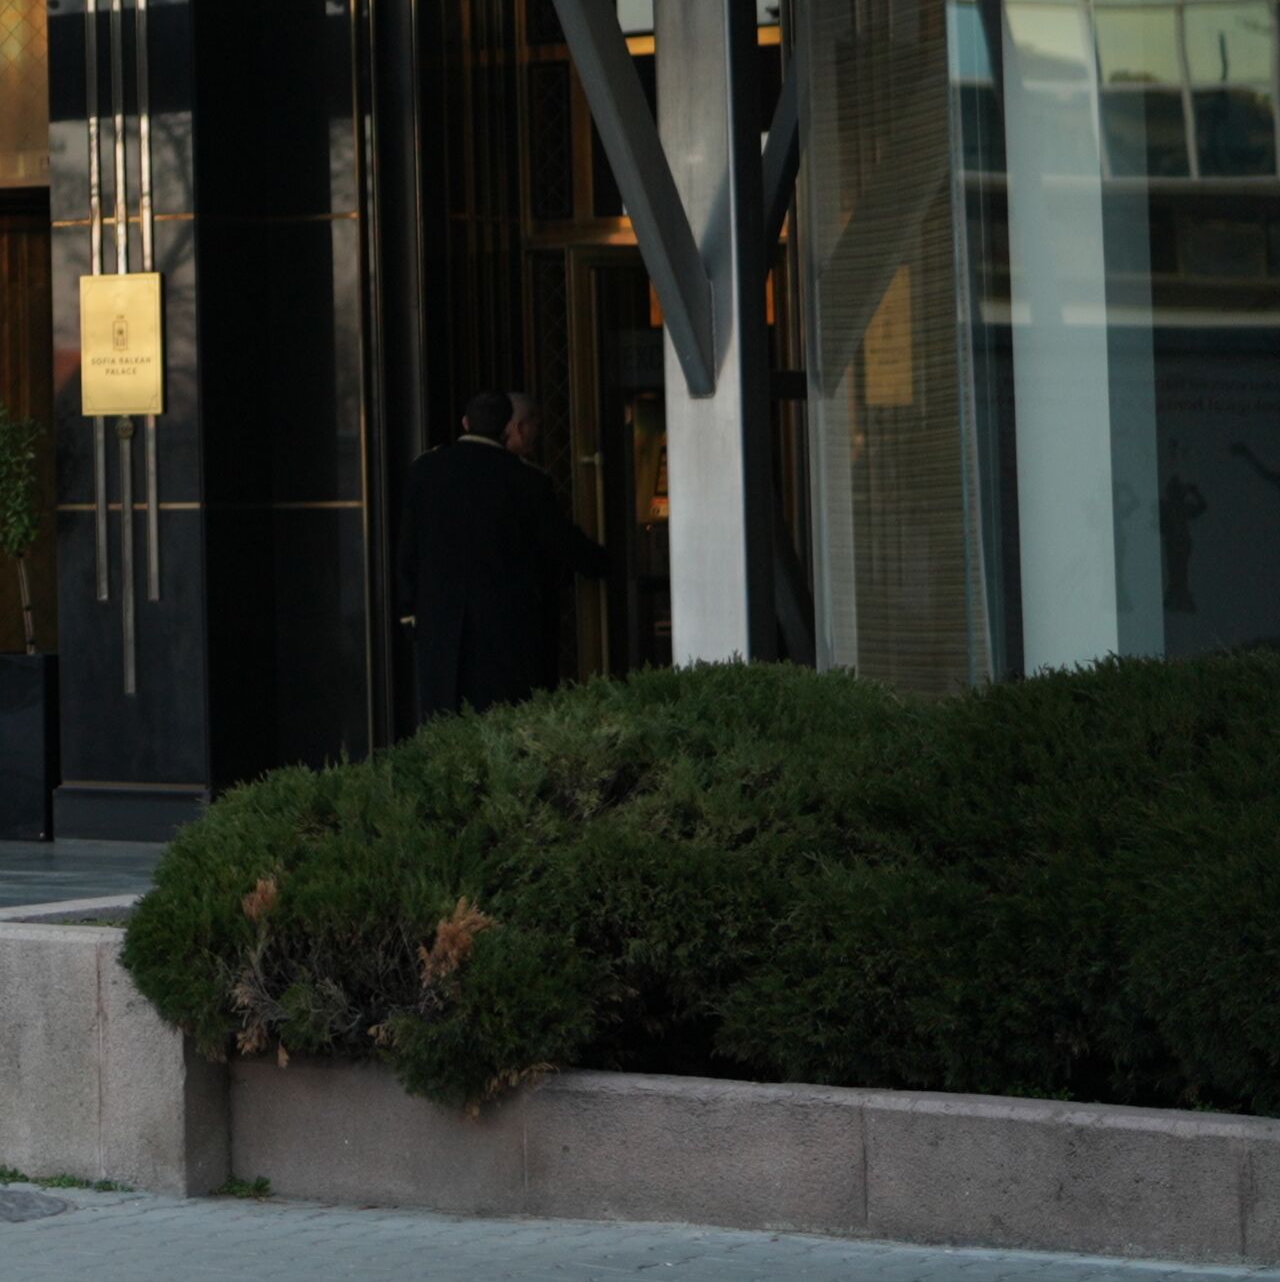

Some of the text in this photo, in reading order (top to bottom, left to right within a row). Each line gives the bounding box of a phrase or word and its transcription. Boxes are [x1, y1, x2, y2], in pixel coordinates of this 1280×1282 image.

[91, 356, 152, 366] SOFIA BALKAN
[105, 367, 137, 376] PALACE
